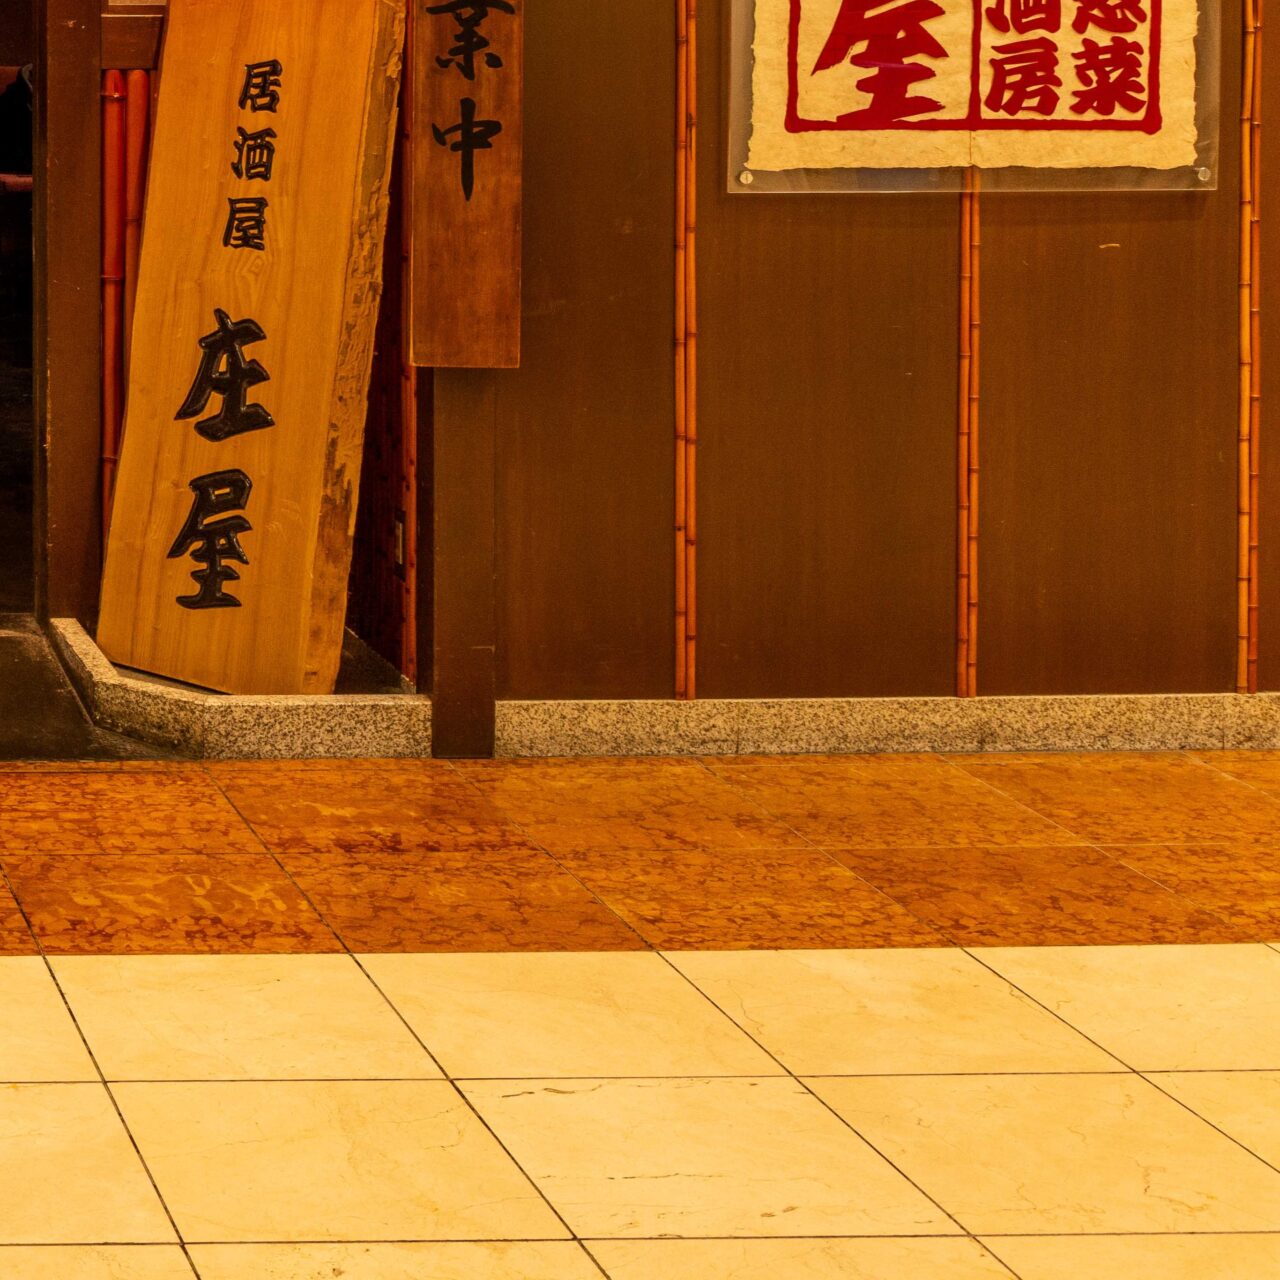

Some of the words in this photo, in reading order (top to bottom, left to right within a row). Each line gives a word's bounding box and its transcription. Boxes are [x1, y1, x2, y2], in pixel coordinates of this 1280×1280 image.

[222, 58, 284, 252] 居酒屋
[166, 307, 275, 611] 庄屋
